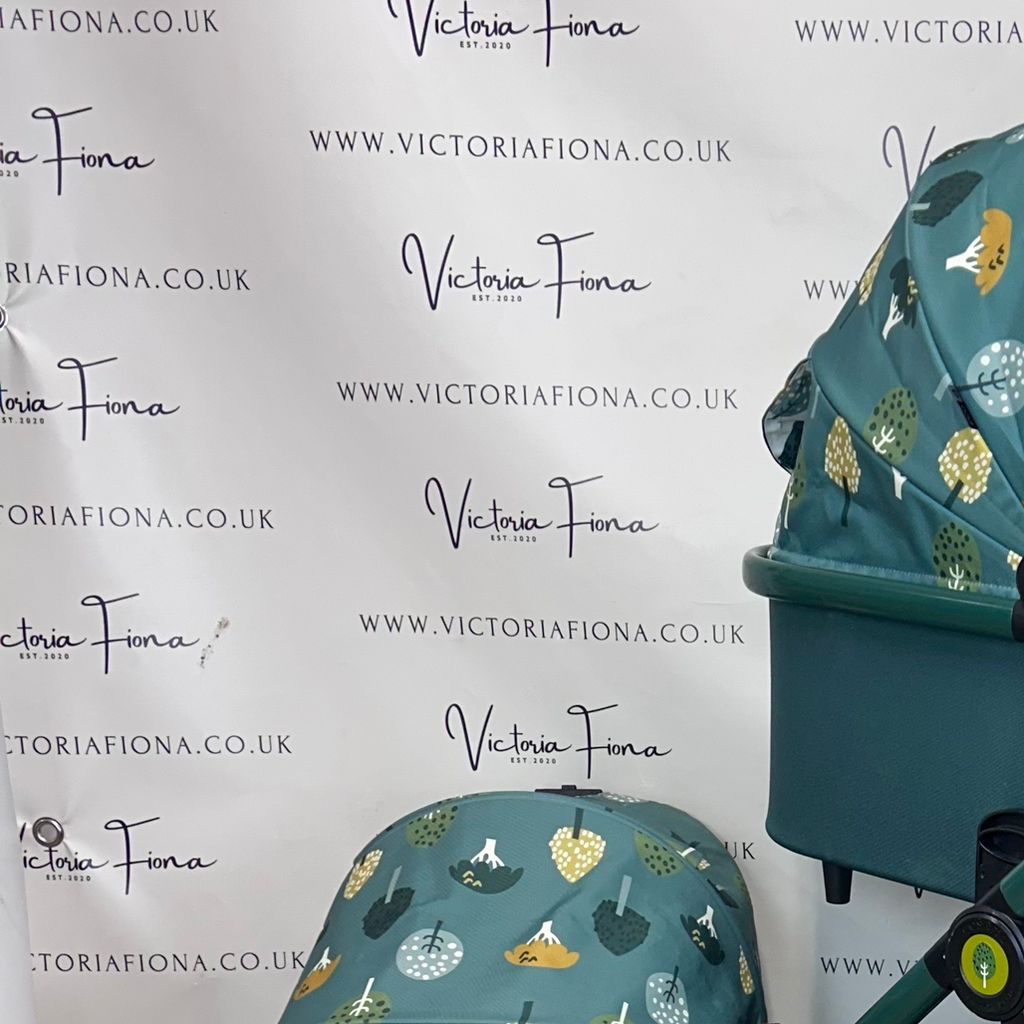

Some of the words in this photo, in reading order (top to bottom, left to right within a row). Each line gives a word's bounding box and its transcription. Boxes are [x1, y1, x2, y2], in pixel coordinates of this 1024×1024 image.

[460, 41, 511, 50] EST.2020
[31, 106, 155, 196] Fiona
[309, 131, 732, 162] WWW.VICTORIAFIONA.CO.UK
[402, 233, 541, 311] Victoria
[537, 232, 652, 319] Fiona
[472, 294, 523, 302] EST.2020
[57, 356, 181, 441] Fiona
[337, 381, 739, 410] WWW.VICTORIAFIONA.CO.UK
[0, 504, 275, 529] ORIAFIONA.CO.UK
[425, 477, 554, 549] Victoria
[549, 475, 659, 558] Fiona
[490, 535, 537, 543] EST.2020
[81, 593, 200, 674] Fiona
[359, 614, 746, 645] WWW.VICTORIAFIONA.CO.UK
[445, 703, 573, 771] Victoria
[567, 703, 673, 779] Fiona
[19, 822, 110, 873] ictoria
[104, 816, 219, 895] Fiona
[46, 874, 92, 882] EST.2020
[30, 951, 305, 972] TORIAFIONA.CO.UK
